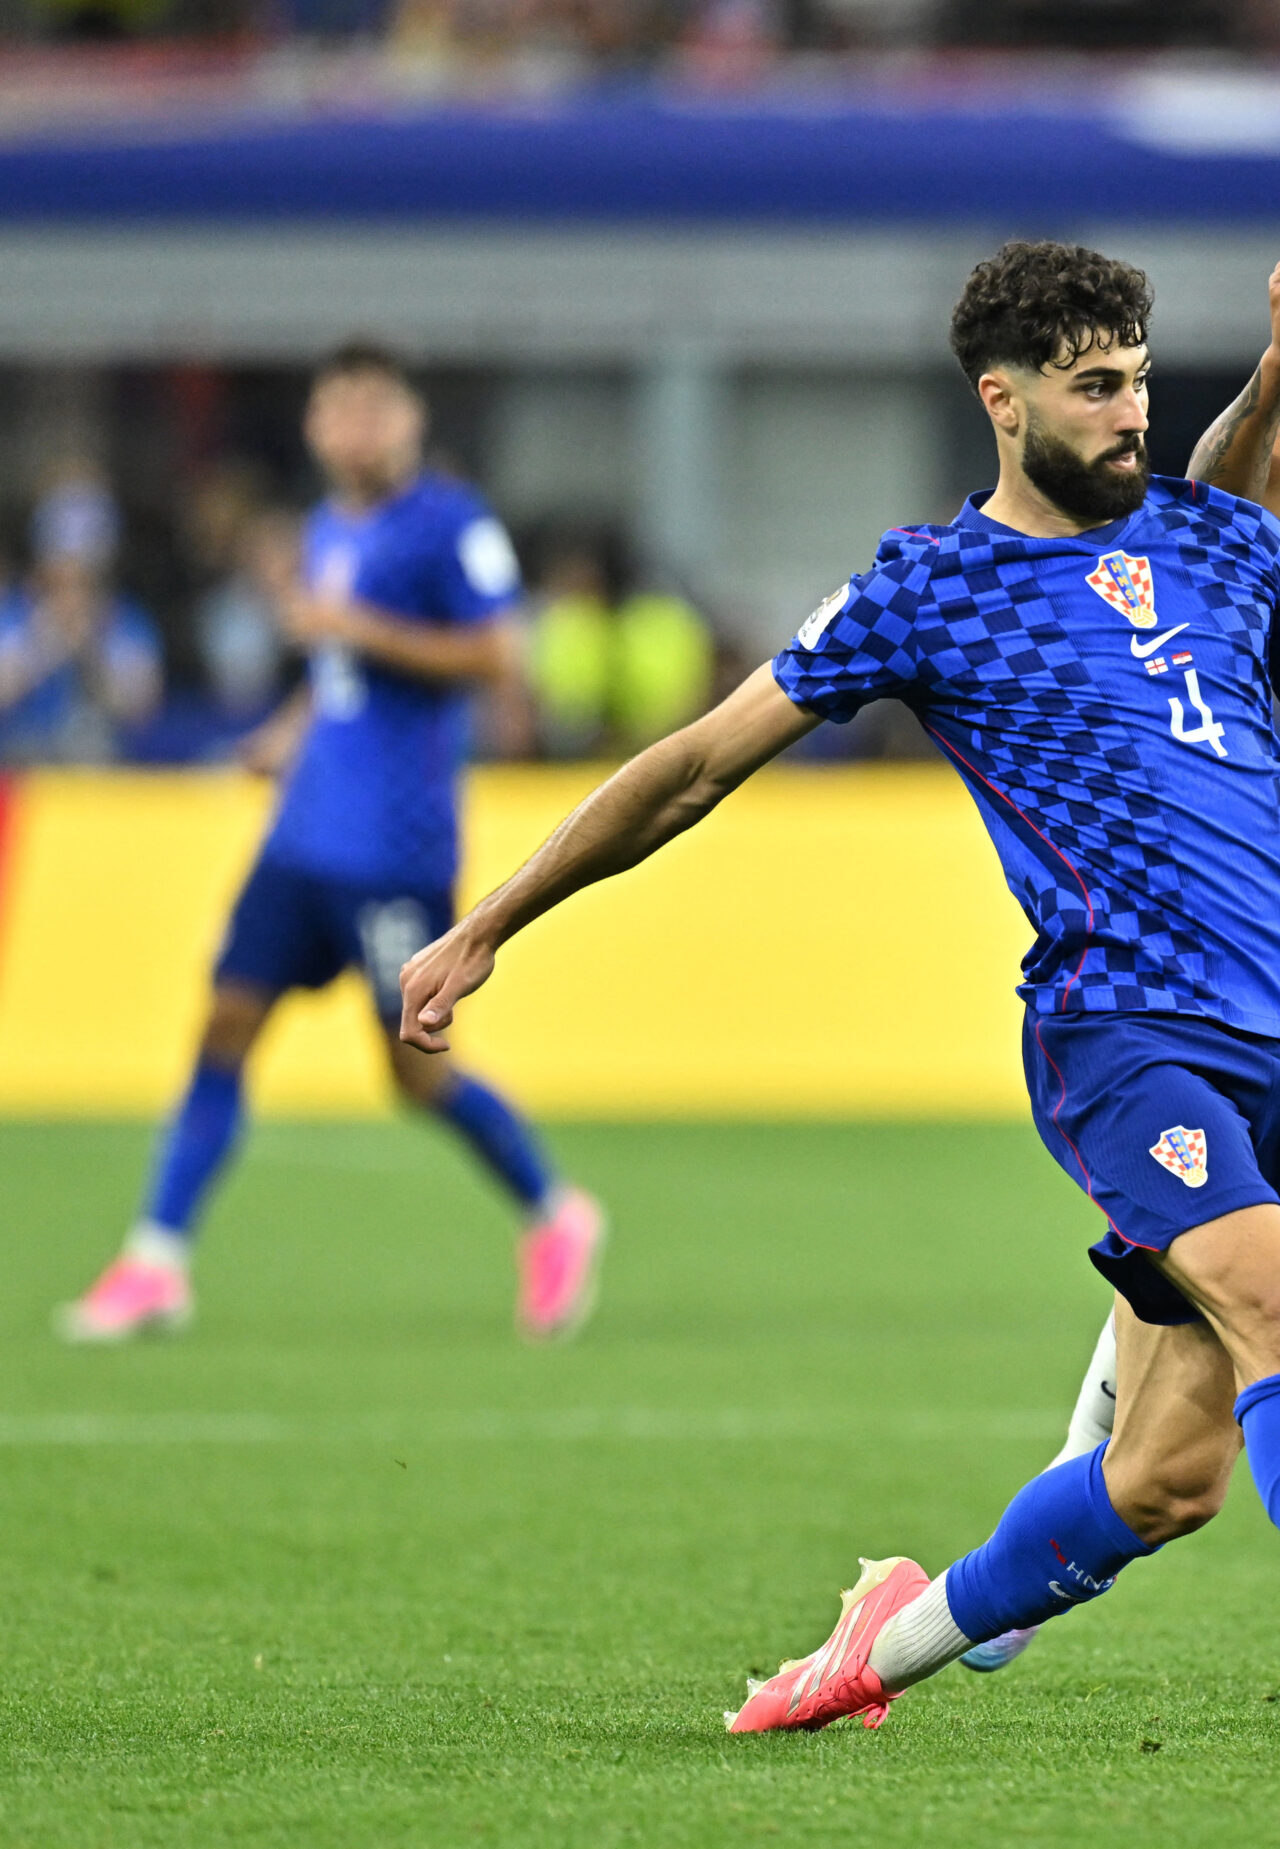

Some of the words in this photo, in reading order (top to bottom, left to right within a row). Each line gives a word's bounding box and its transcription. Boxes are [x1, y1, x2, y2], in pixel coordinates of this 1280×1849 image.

[1110, 560, 1135, 600] HNS
[1167, 668, 1228, 757] 4
[1170, 1135, 1190, 1164] HNS
